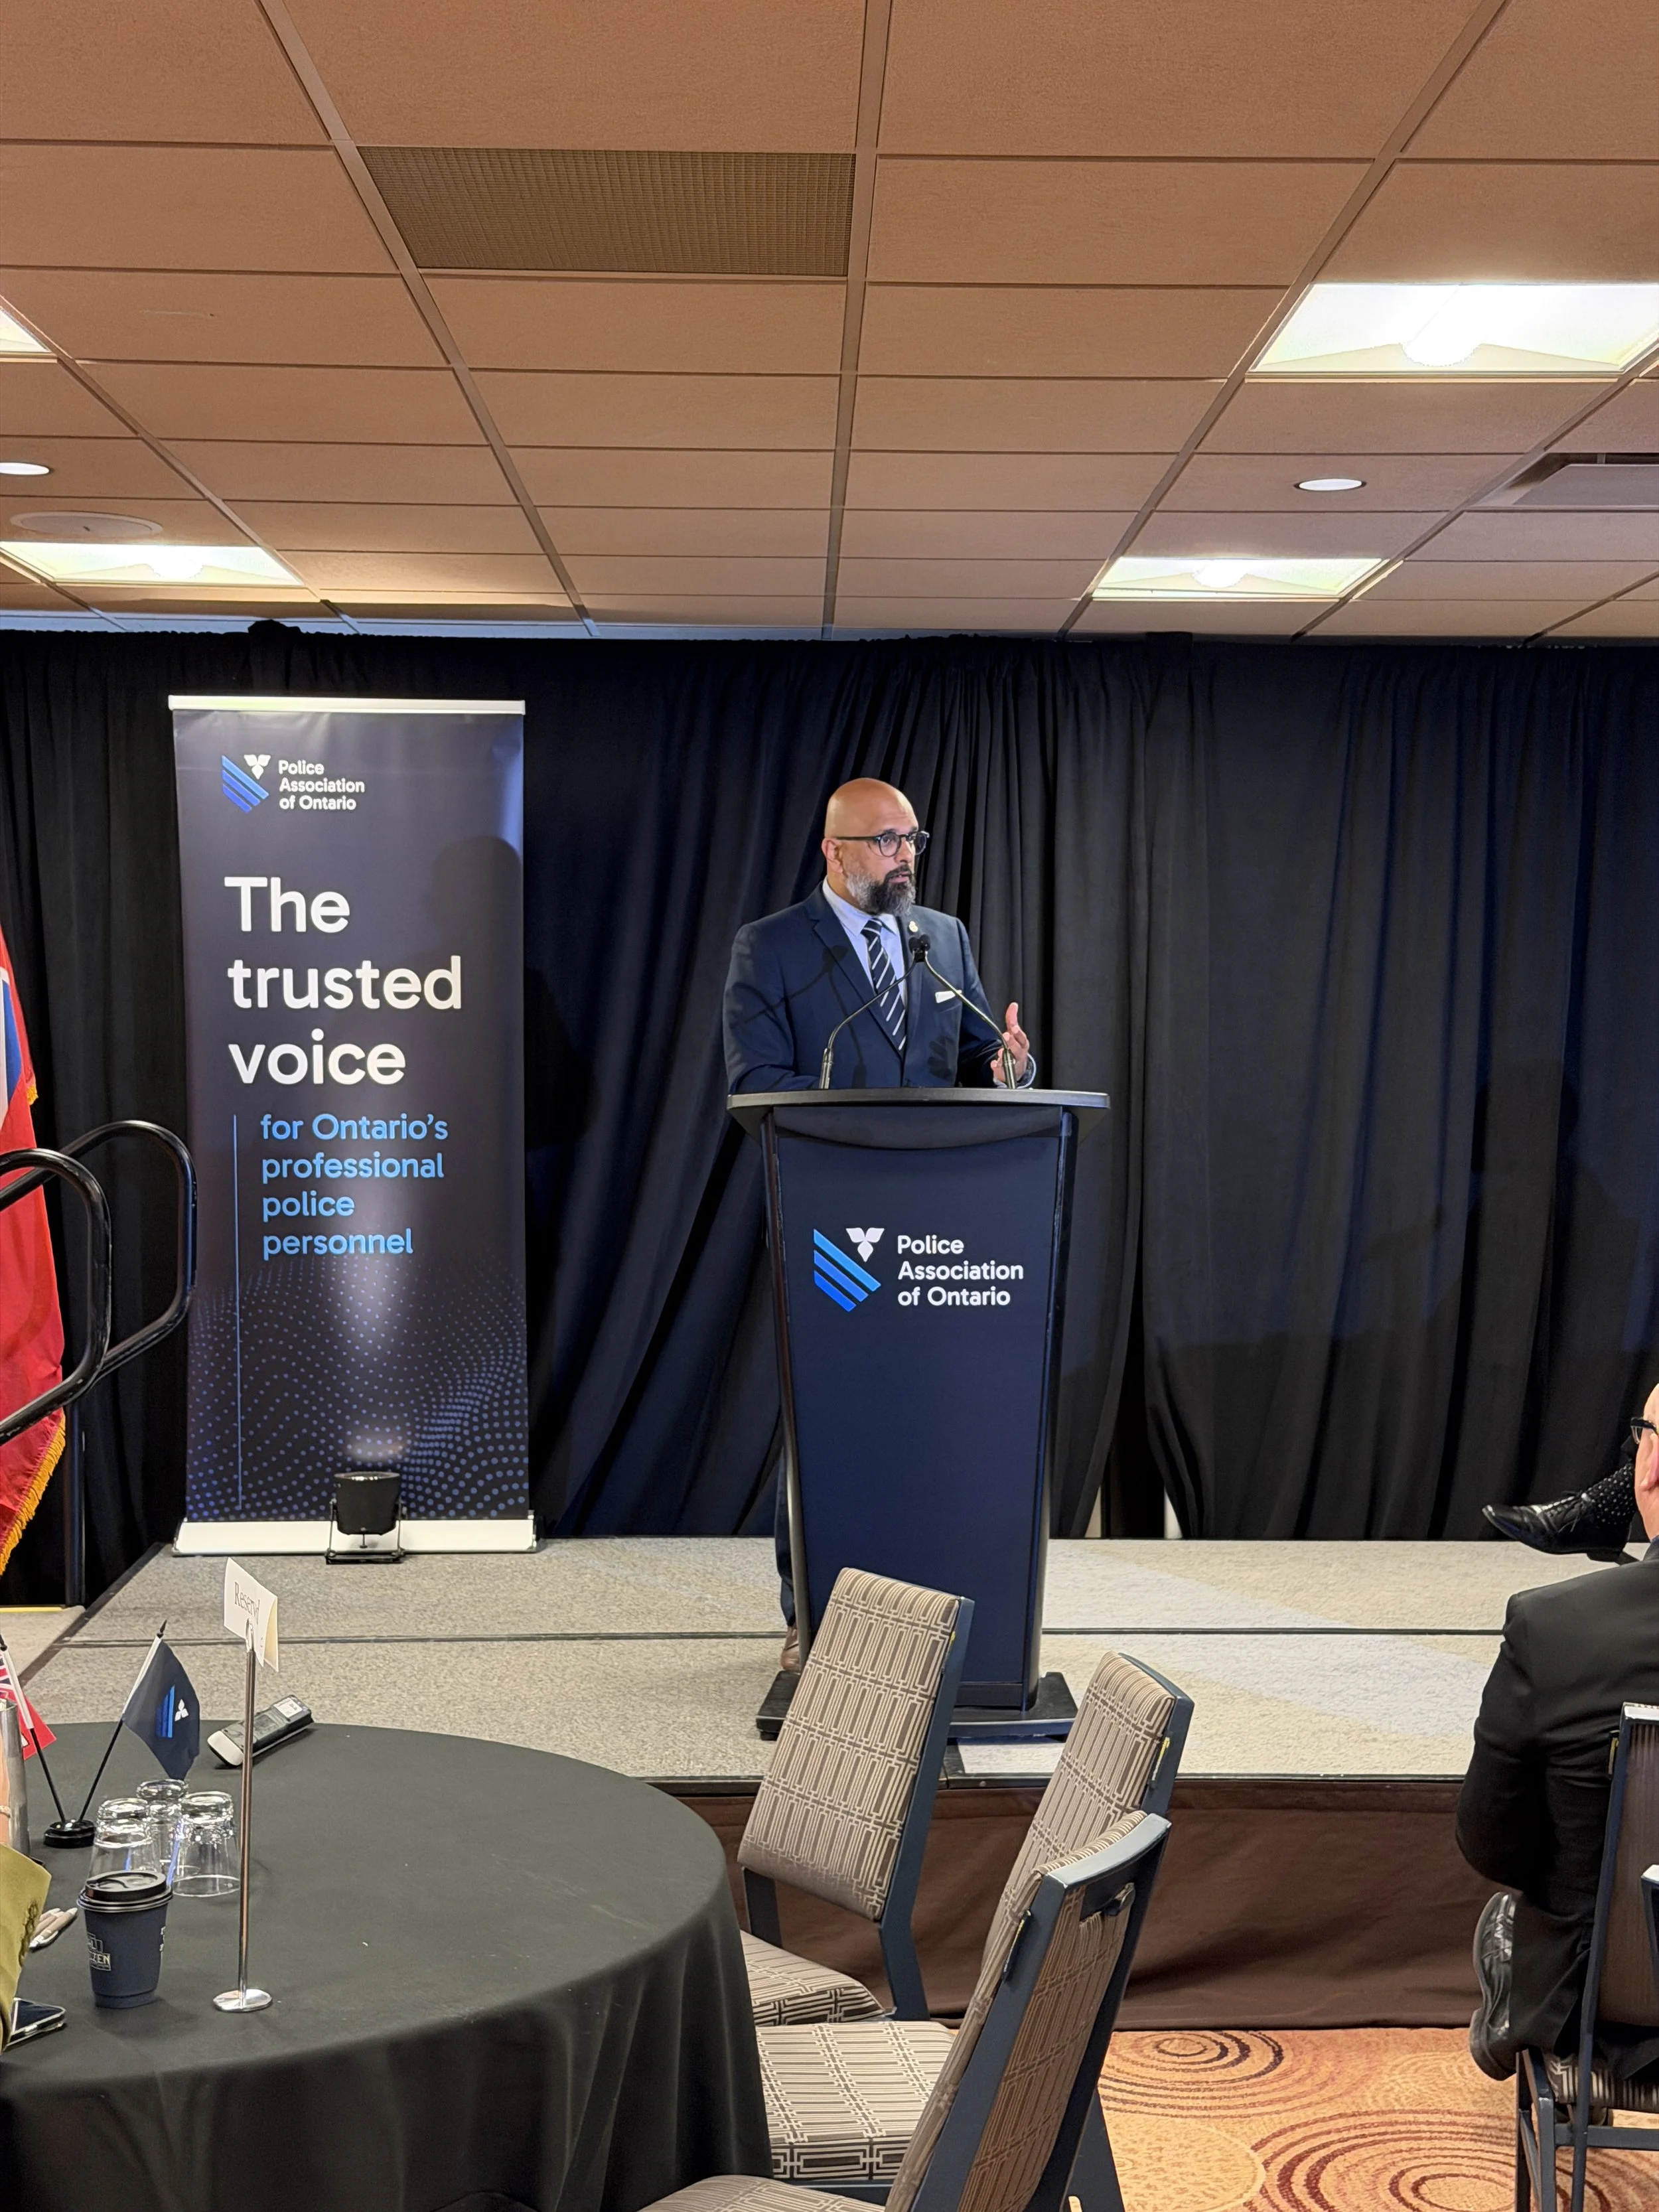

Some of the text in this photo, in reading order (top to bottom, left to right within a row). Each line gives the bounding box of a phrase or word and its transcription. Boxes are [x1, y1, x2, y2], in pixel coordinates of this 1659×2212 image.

[279, 760, 325, 775] Police
[279, 777, 365, 793] Association
[279, 794, 357, 810] of Ontario
[224, 876, 350, 933] The
[228, 954, 462, 1010] trusted
[228, 1029, 406, 1085] voice
[261, 1113, 448, 1140] for Ontario’s
[261, 1151, 444, 1184] professional
[262, 1190, 355, 1222] police
[263, 1228, 413, 1260] personnel
[897, 1234, 964, 1254] Police
[897, 1260, 1024, 1280] Association
[897, 1286, 1011, 1306] of Ontario
